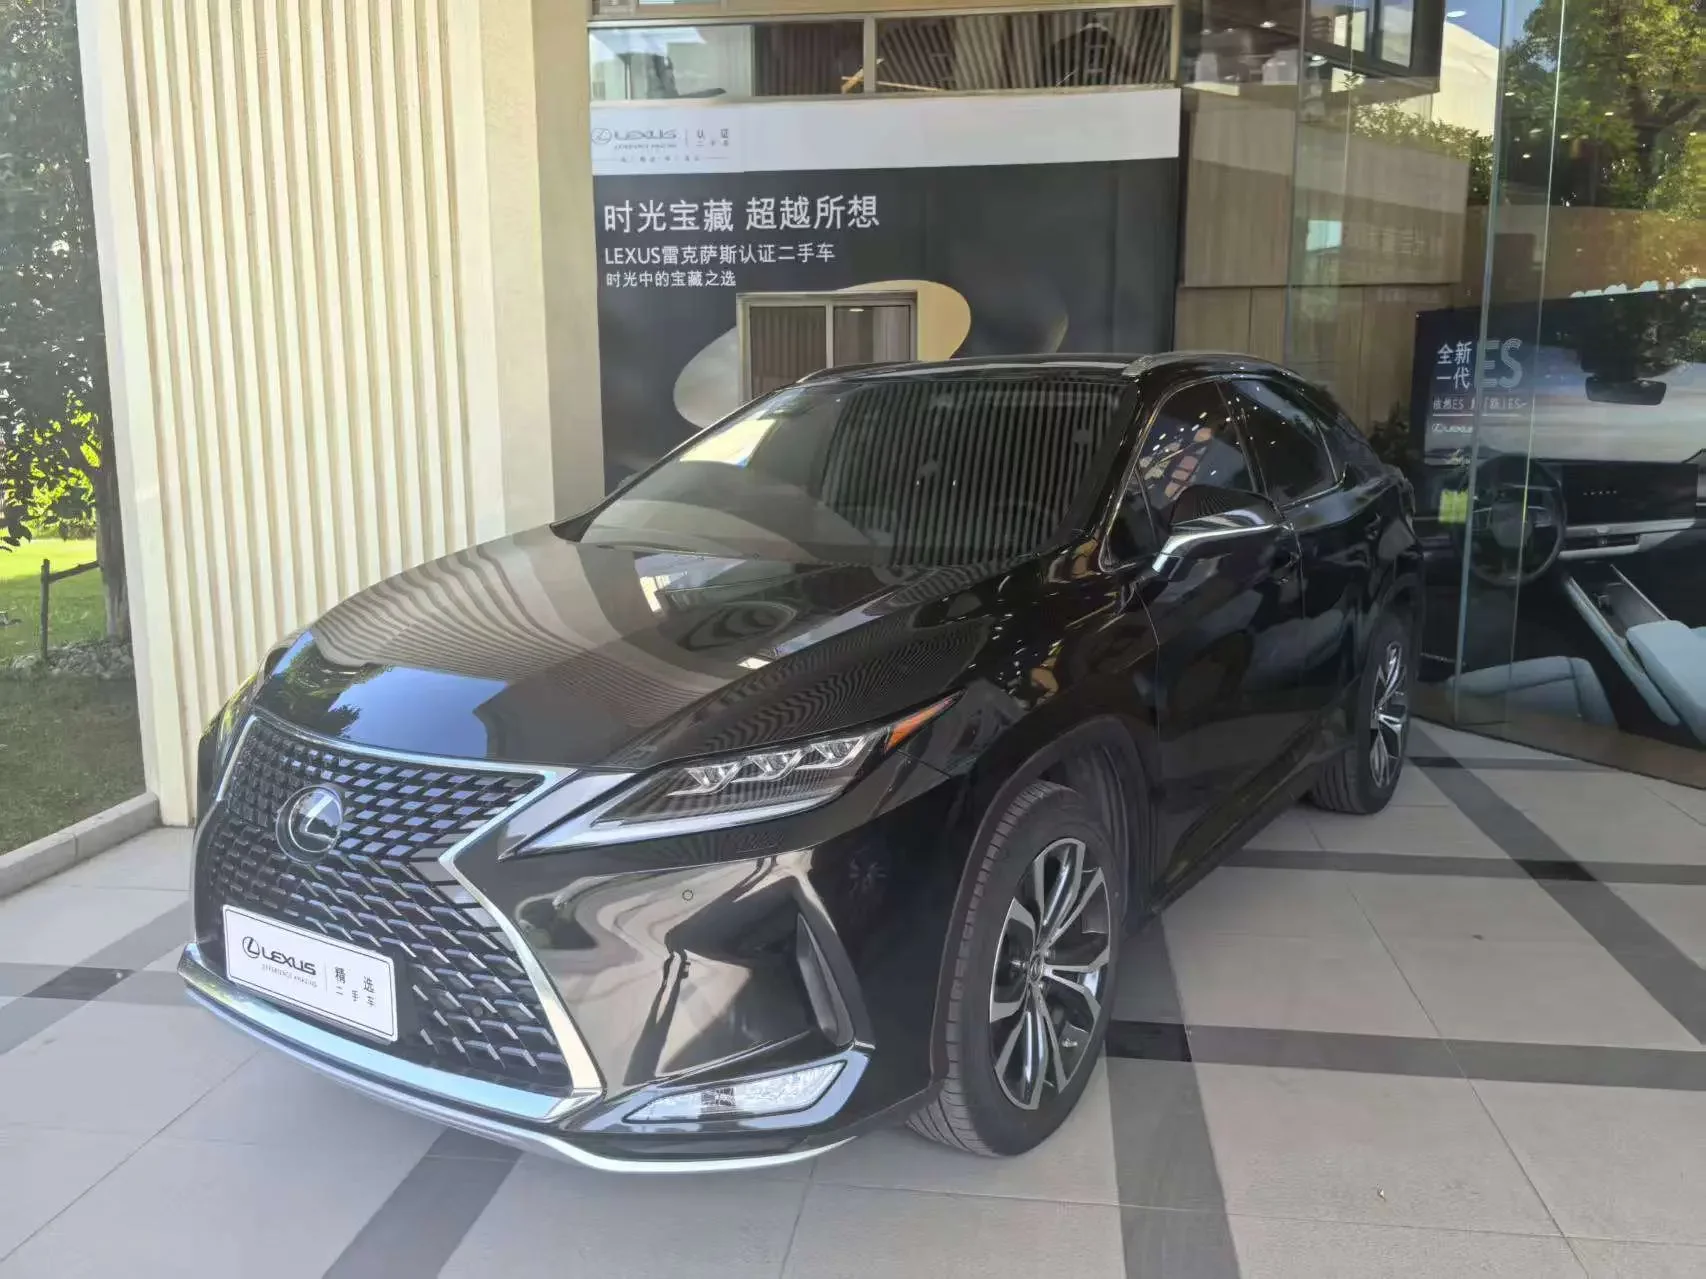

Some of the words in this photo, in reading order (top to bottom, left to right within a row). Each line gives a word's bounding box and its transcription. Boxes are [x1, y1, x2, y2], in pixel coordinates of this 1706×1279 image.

[603, 199, 734, 233] 时光宝藏
[745, 195, 880, 231] 超越所想
[605, 243, 836, 265] LEXUS雷克萨斯认证二手车
[606, 270, 737, 289] 时光中的宝藏之选
[1437, 341, 1473, 365] 全新
[1475, 337, 1523, 388] ES
[1436, 366, 1472, 390] 一代
[261, 946, 317, 976] LEXUS
[334, 966, 376, 994] 精选
